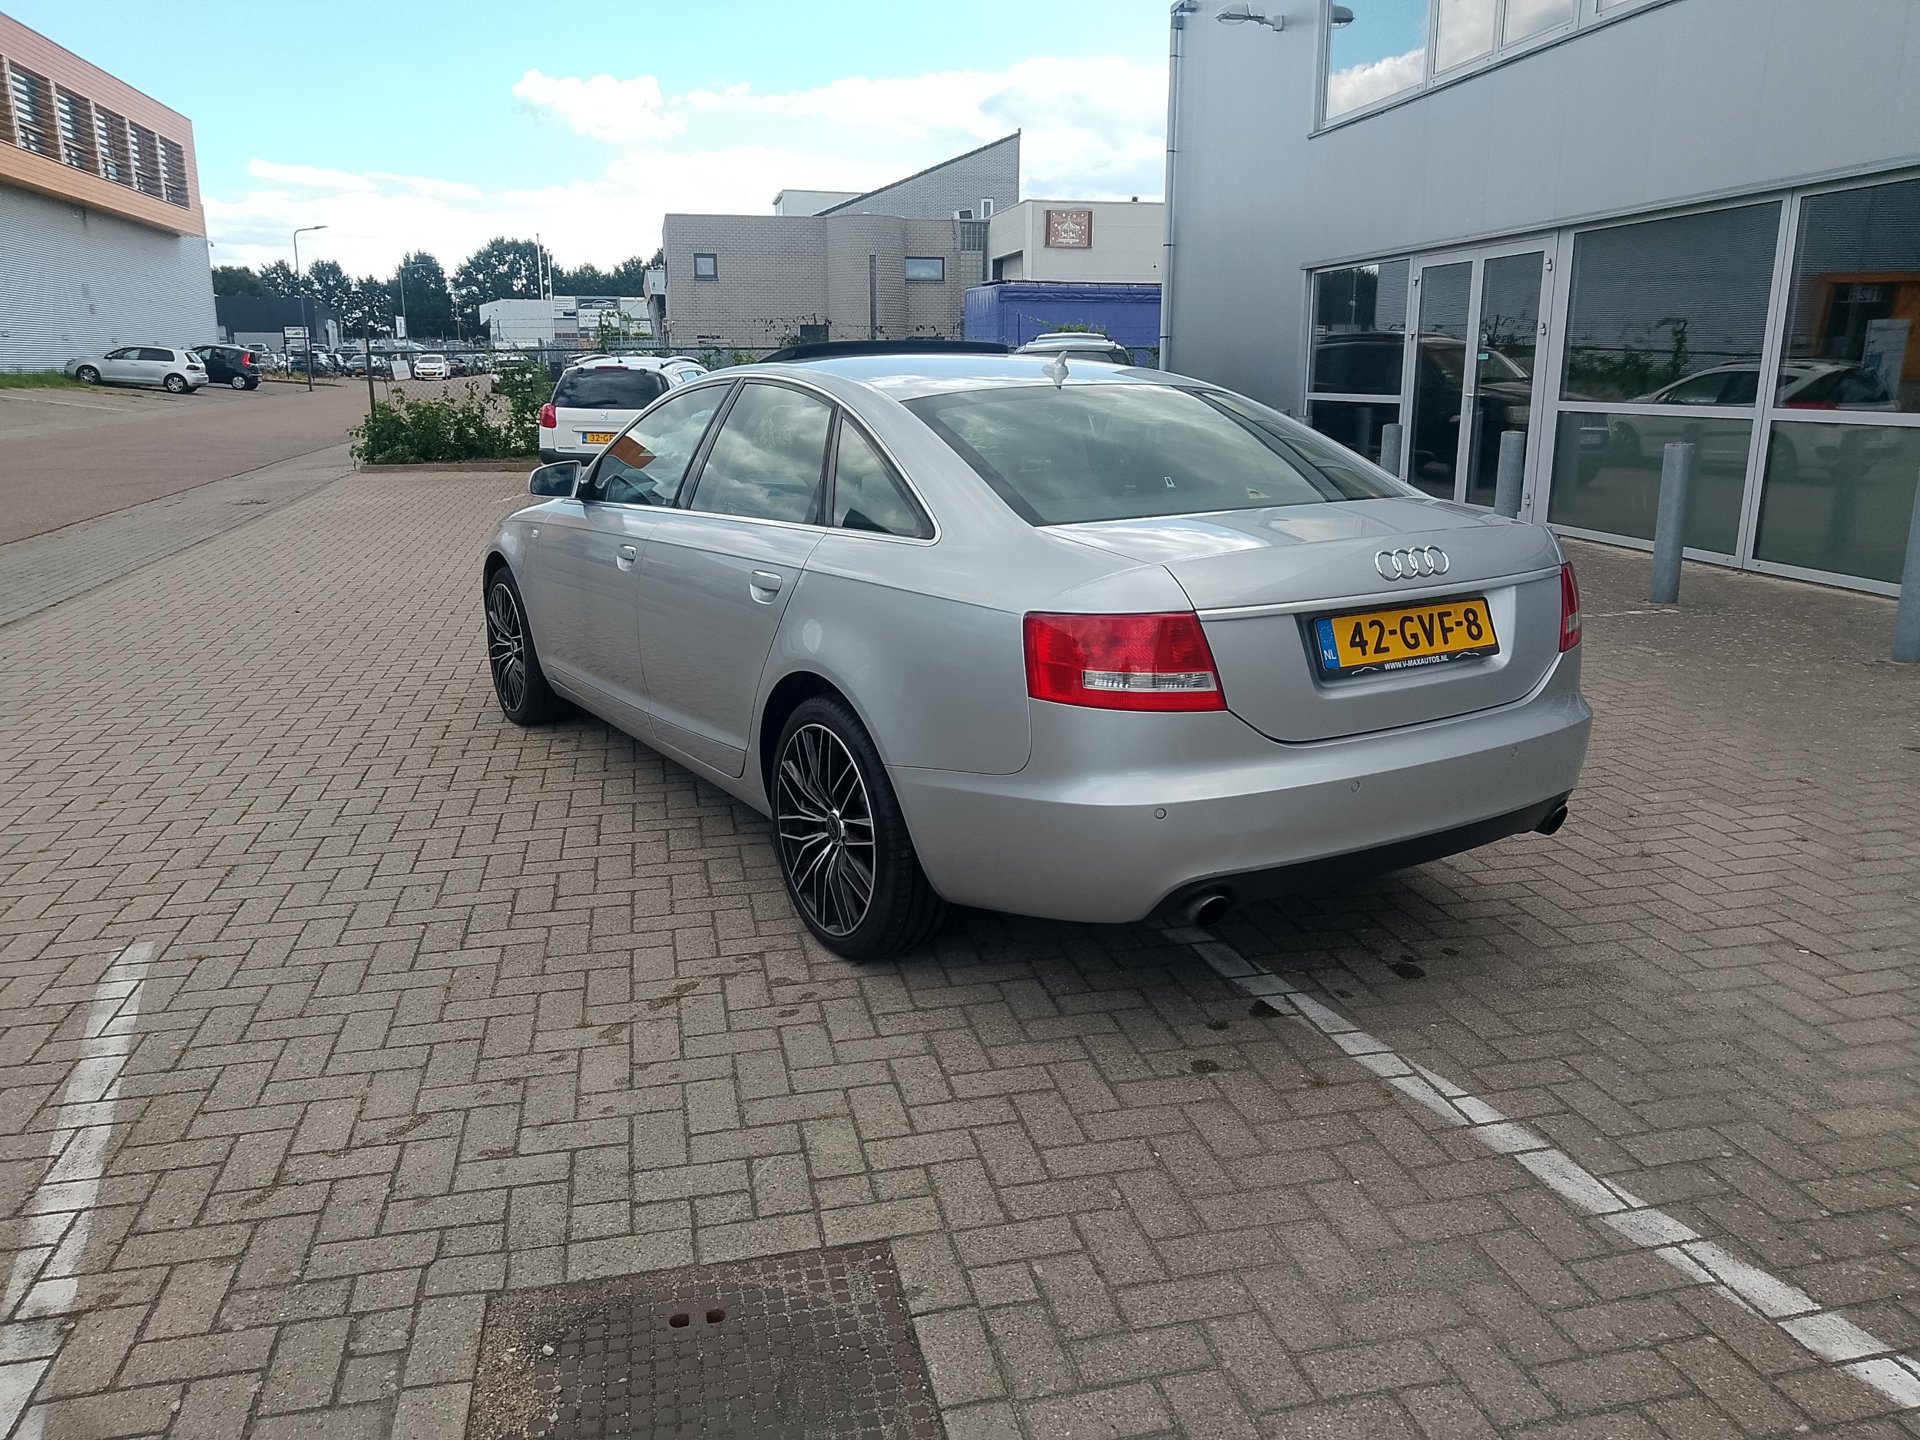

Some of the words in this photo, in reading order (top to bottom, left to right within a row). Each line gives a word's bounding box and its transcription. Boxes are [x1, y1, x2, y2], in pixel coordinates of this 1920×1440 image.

[1349, 608, 1483, 657] 42-GVF-8
[1323, 650, 1337, 661] NL
[1384, 654, 1449, 671] WWW.V-MAXAUTOS.NL
